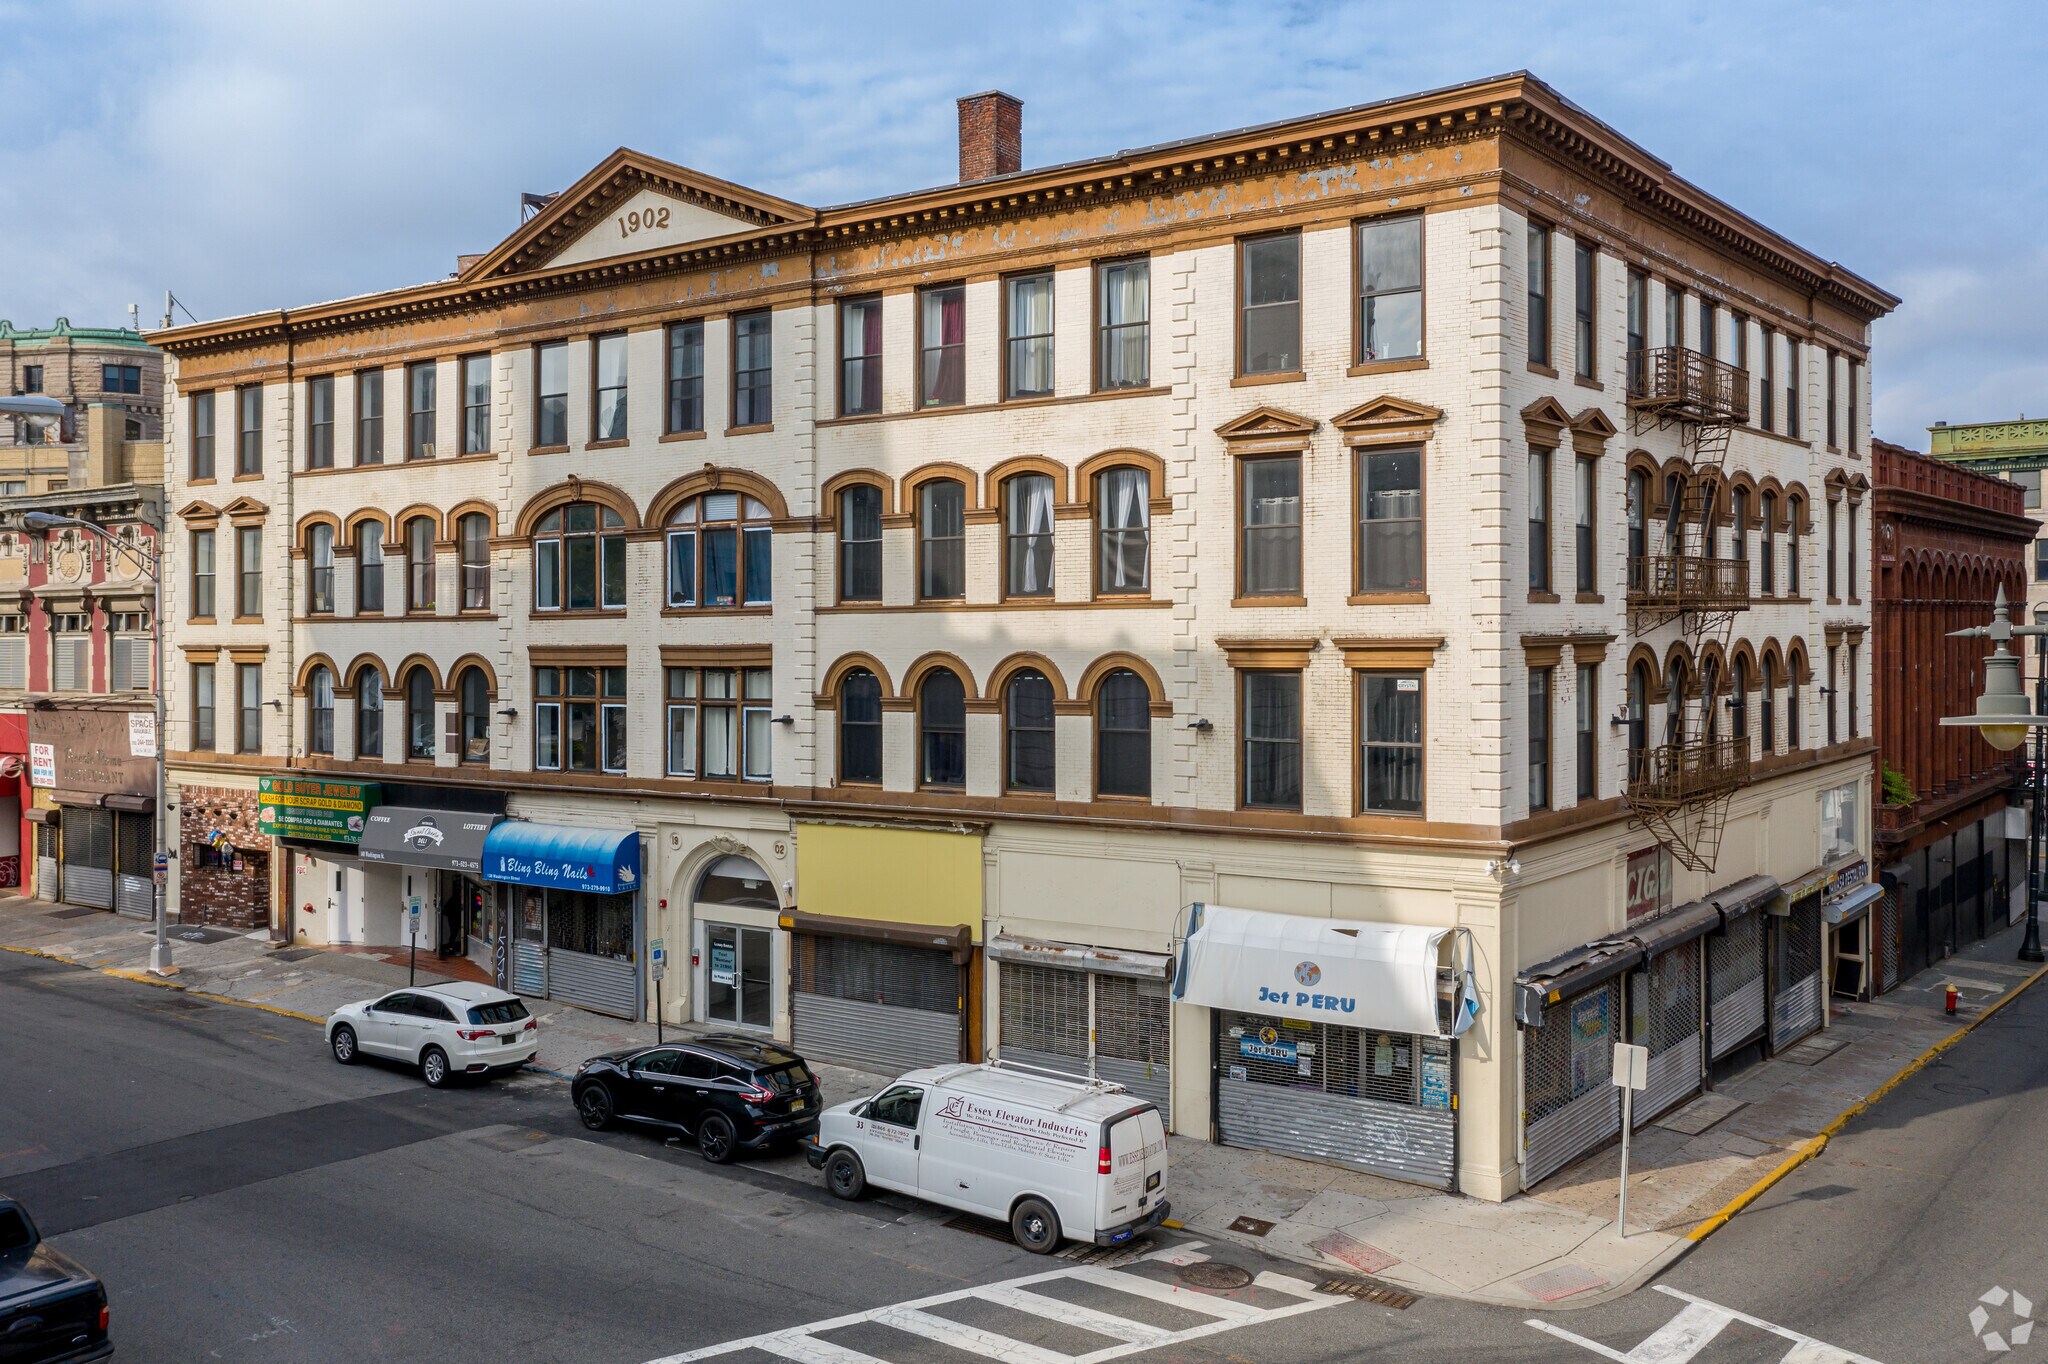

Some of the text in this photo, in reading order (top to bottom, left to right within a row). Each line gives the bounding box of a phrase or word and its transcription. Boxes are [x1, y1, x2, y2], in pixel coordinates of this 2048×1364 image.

[618, 207, 671, 239] 1902
[130, 719, 154, 729] SPACE
[35, 745, 49, 756] FOR
[34, 757, 52, 768] RENT
[272, 780, 361, 798] GOLD BUYER JEWELRY
[262, 794, 274, 803] CASH
[275, 795, 285, 804] FOR
[286, 796, 299, 805] YOUR
[300, 798, 317, 807] SCRAP
[338, 801, 362, 810] DIAMOND
[285, 816, 303, 824] COMPRA
[303, 817, 312, 825] ORO
[316, 819, 343, 828] DIAMANTES
[370, 815, 391, 823] COFFEE
[463, 823, 488, 831] LOTTERY
[774, 844, 784, 855] 02
[507, 857, 588, 881] Bling Bling Nails
[1259, 987, 1355, 1013] Jet PERU
[1248, 1043, 1288, 1058] Jet PERU
[856, 1120, 864, 1129] 33
[967, 1103, 1088, 1138] Essex Elevator Industries
[1052, 1133, 1077, 1143] Perfected
[1013, 1139, 1046, 1152] Residential
[1047, 1147, 1075, 1159] Elevators
[1022, 1136, 1044, 1147] Service
[1053, 1142, 1076, 1154] Repairs
